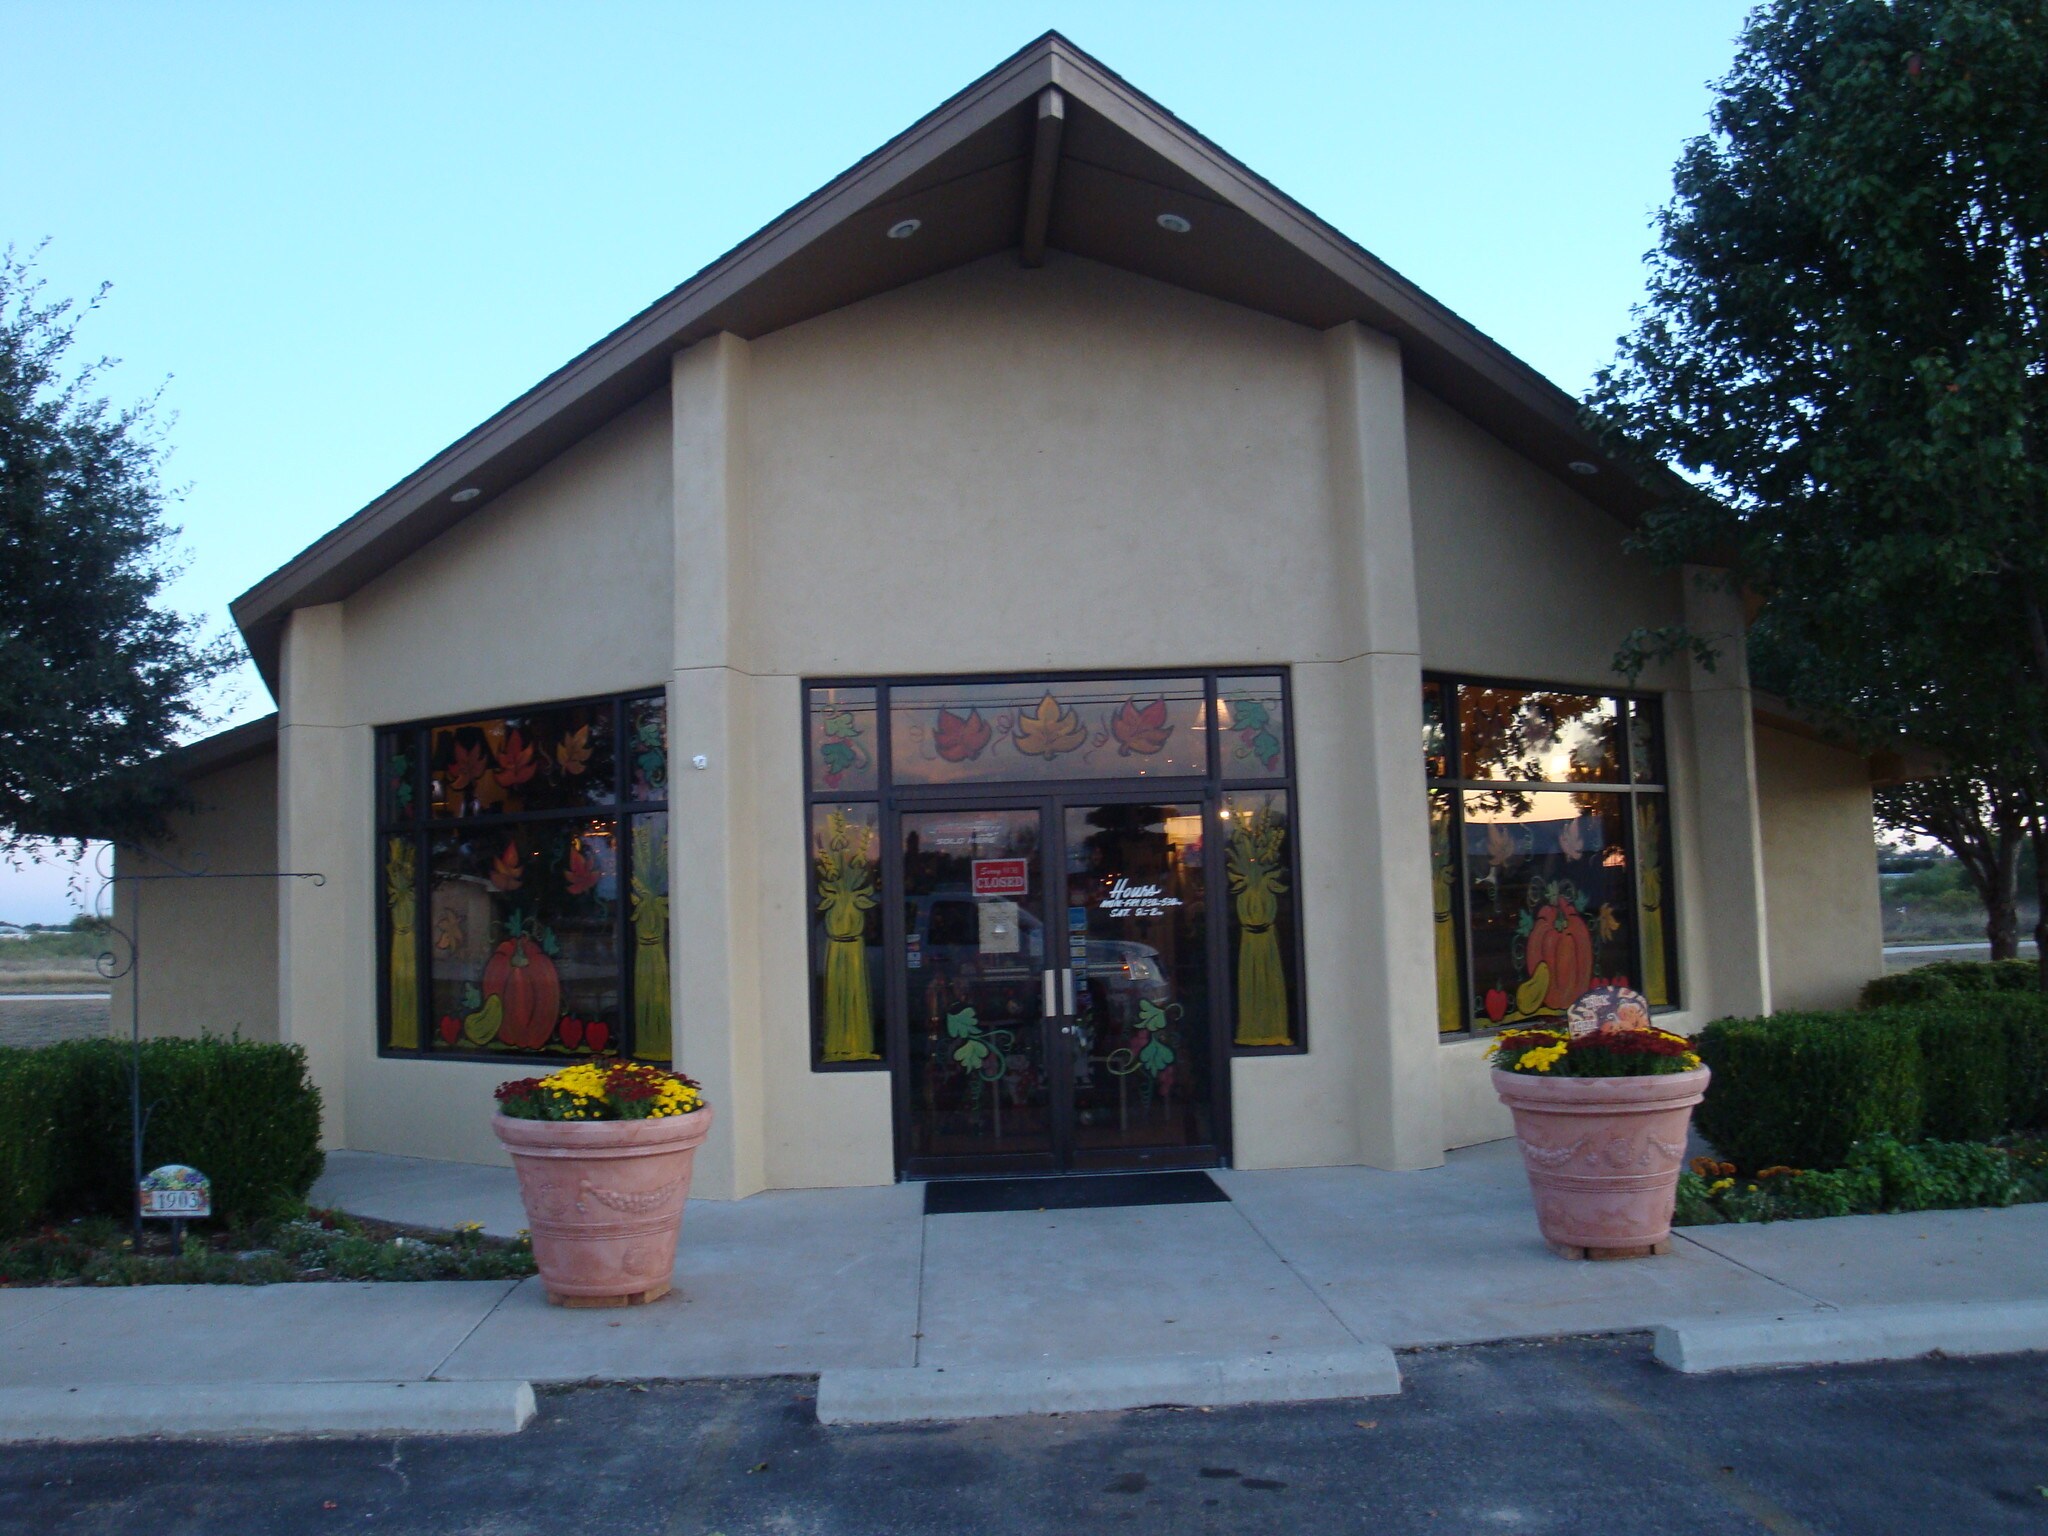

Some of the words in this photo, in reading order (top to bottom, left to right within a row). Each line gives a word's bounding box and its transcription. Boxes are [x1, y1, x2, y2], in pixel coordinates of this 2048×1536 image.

[976, 876, 1024, 889] CLOSED
[1109, 877, 1162, 900] Hours
[159, 1191, 200, 1209] 1903
